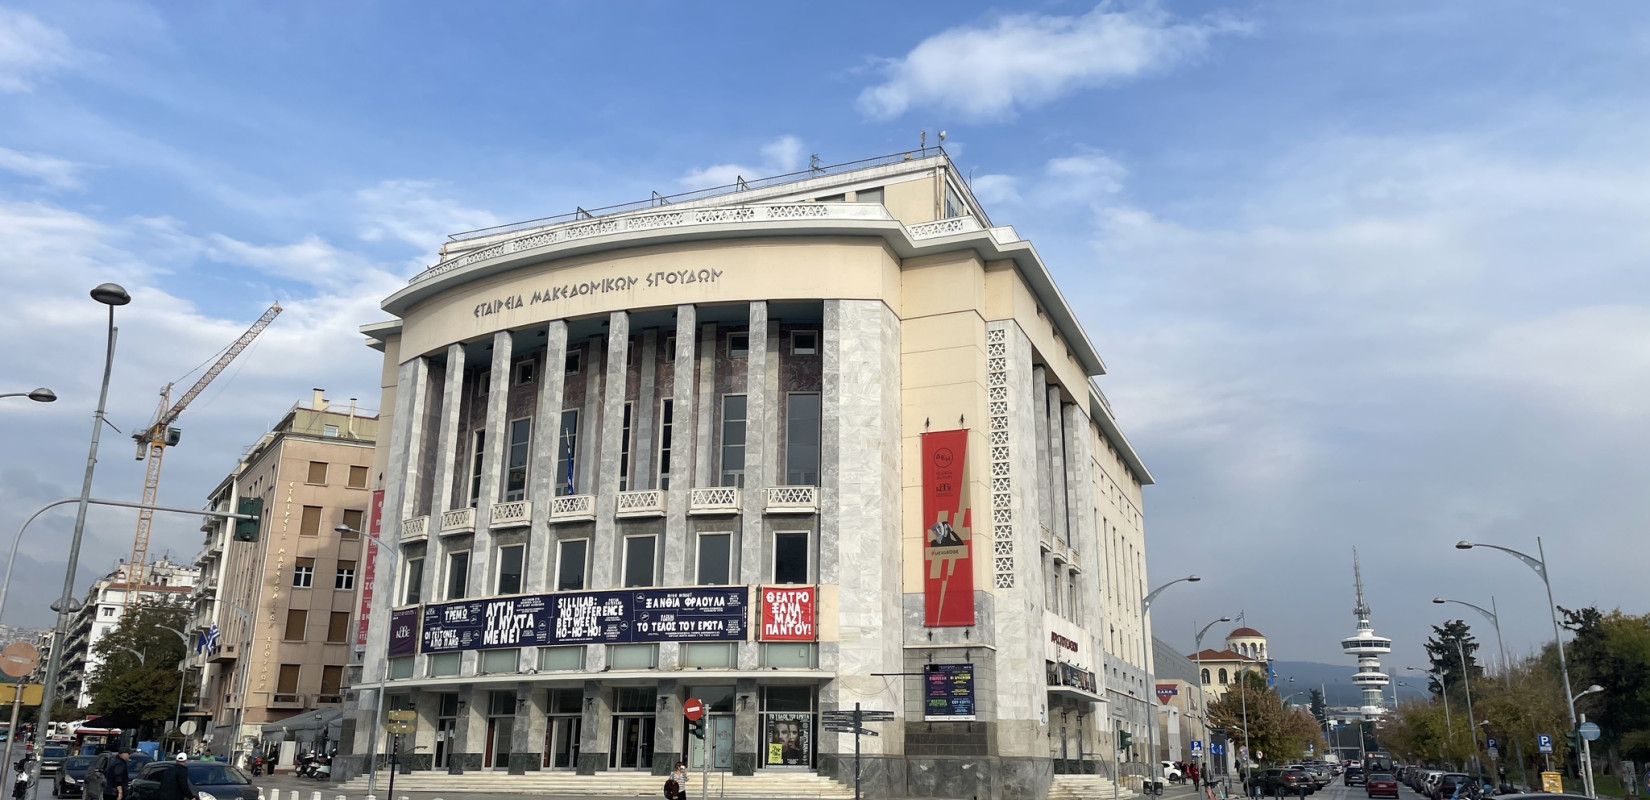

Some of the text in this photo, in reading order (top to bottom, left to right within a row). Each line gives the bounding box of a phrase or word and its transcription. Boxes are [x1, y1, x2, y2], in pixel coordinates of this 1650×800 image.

[473, 267, 723, 318] ΕΤΑΙΡΕΙΑ ΜΑΚΕΔΟΝΙΚΩΝ ΣΠΟΥΔΩΝ
[557, 596, 598, 608] SILLILAB:
[645, 598, 680, 609] ΞΑΝΘΙΑ
[684, 596, 725, 607] ΦΡΑΟΥΛΑ
[766, 591, 809, 603] ΘΕΑΤΡΟ
[444, 608, 468, 621] ΤΡΕΜΩ
[485, 600, 514, 618] ΑΥΤΗ
[560, 605, 624, 619] NO DIFFERENCE
[487, 613, 534, 632] Η ΝΥΧΤΑ
[637, 622, 649, 632] ΤΟ
[652, 621, 677, 632] ΤΕΛΟΣ
[679, 621, 696, 631] ΤΟΥ
[698, 620, 724, 631] ΕΡΩΤΑ
[765, 623, 812, 635] ΠΑΝΤΟΥ!
[483, 628, 520, 645] ΜΕΝΕΙ
[555, 625, 602, 638] HO-HO-HO!
[1489, 739, 1496, 747] P
[1540, 736, 1549, 746] P
